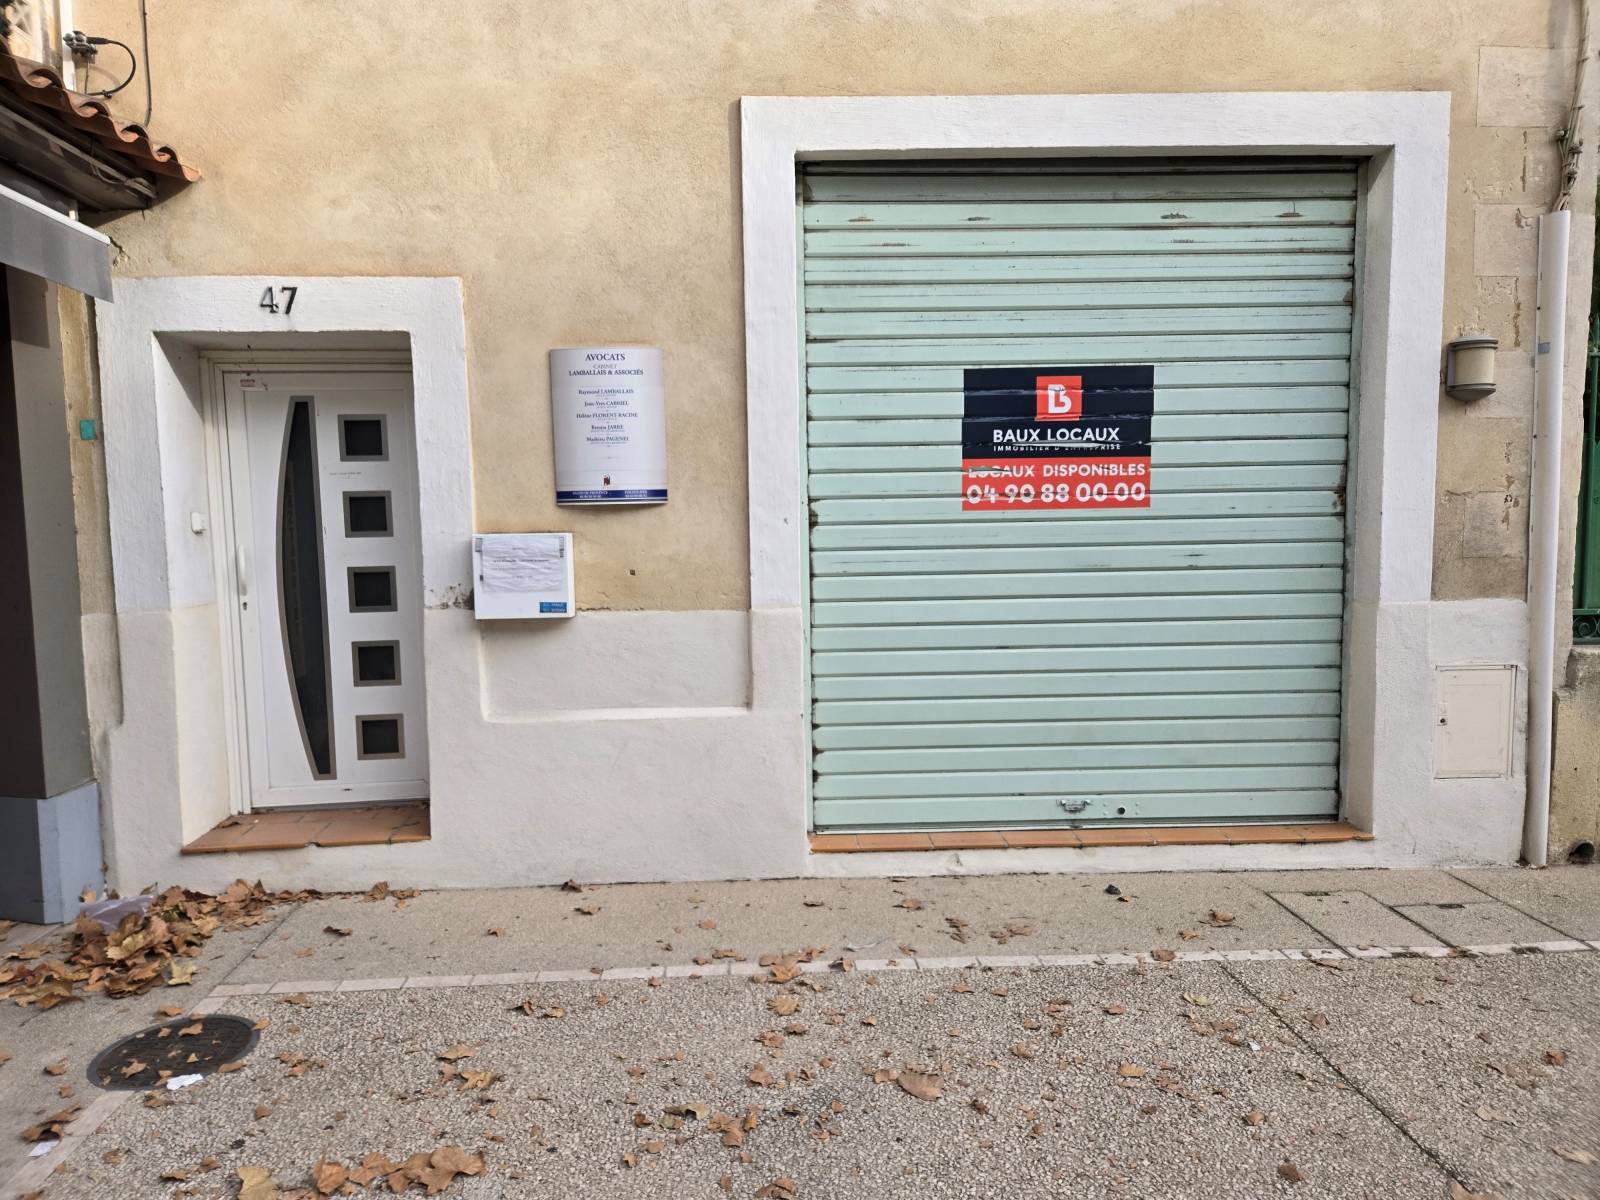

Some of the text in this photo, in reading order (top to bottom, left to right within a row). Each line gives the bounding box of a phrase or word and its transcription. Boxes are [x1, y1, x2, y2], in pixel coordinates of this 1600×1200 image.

[259, 286, 298, 315] 47
[585, 353, 626, 362] AVOCATS
[568, 369, 606, 377] LAMBALLAIS
[1048, 383, 1072, 414] B
[993, 427, 1120, 443] BAUX LOCAUX
[968, 463, 1146, 478] LOCAUX DISPONIBLES
[967, 482, 1146, 504] 04 90 88 00 00
